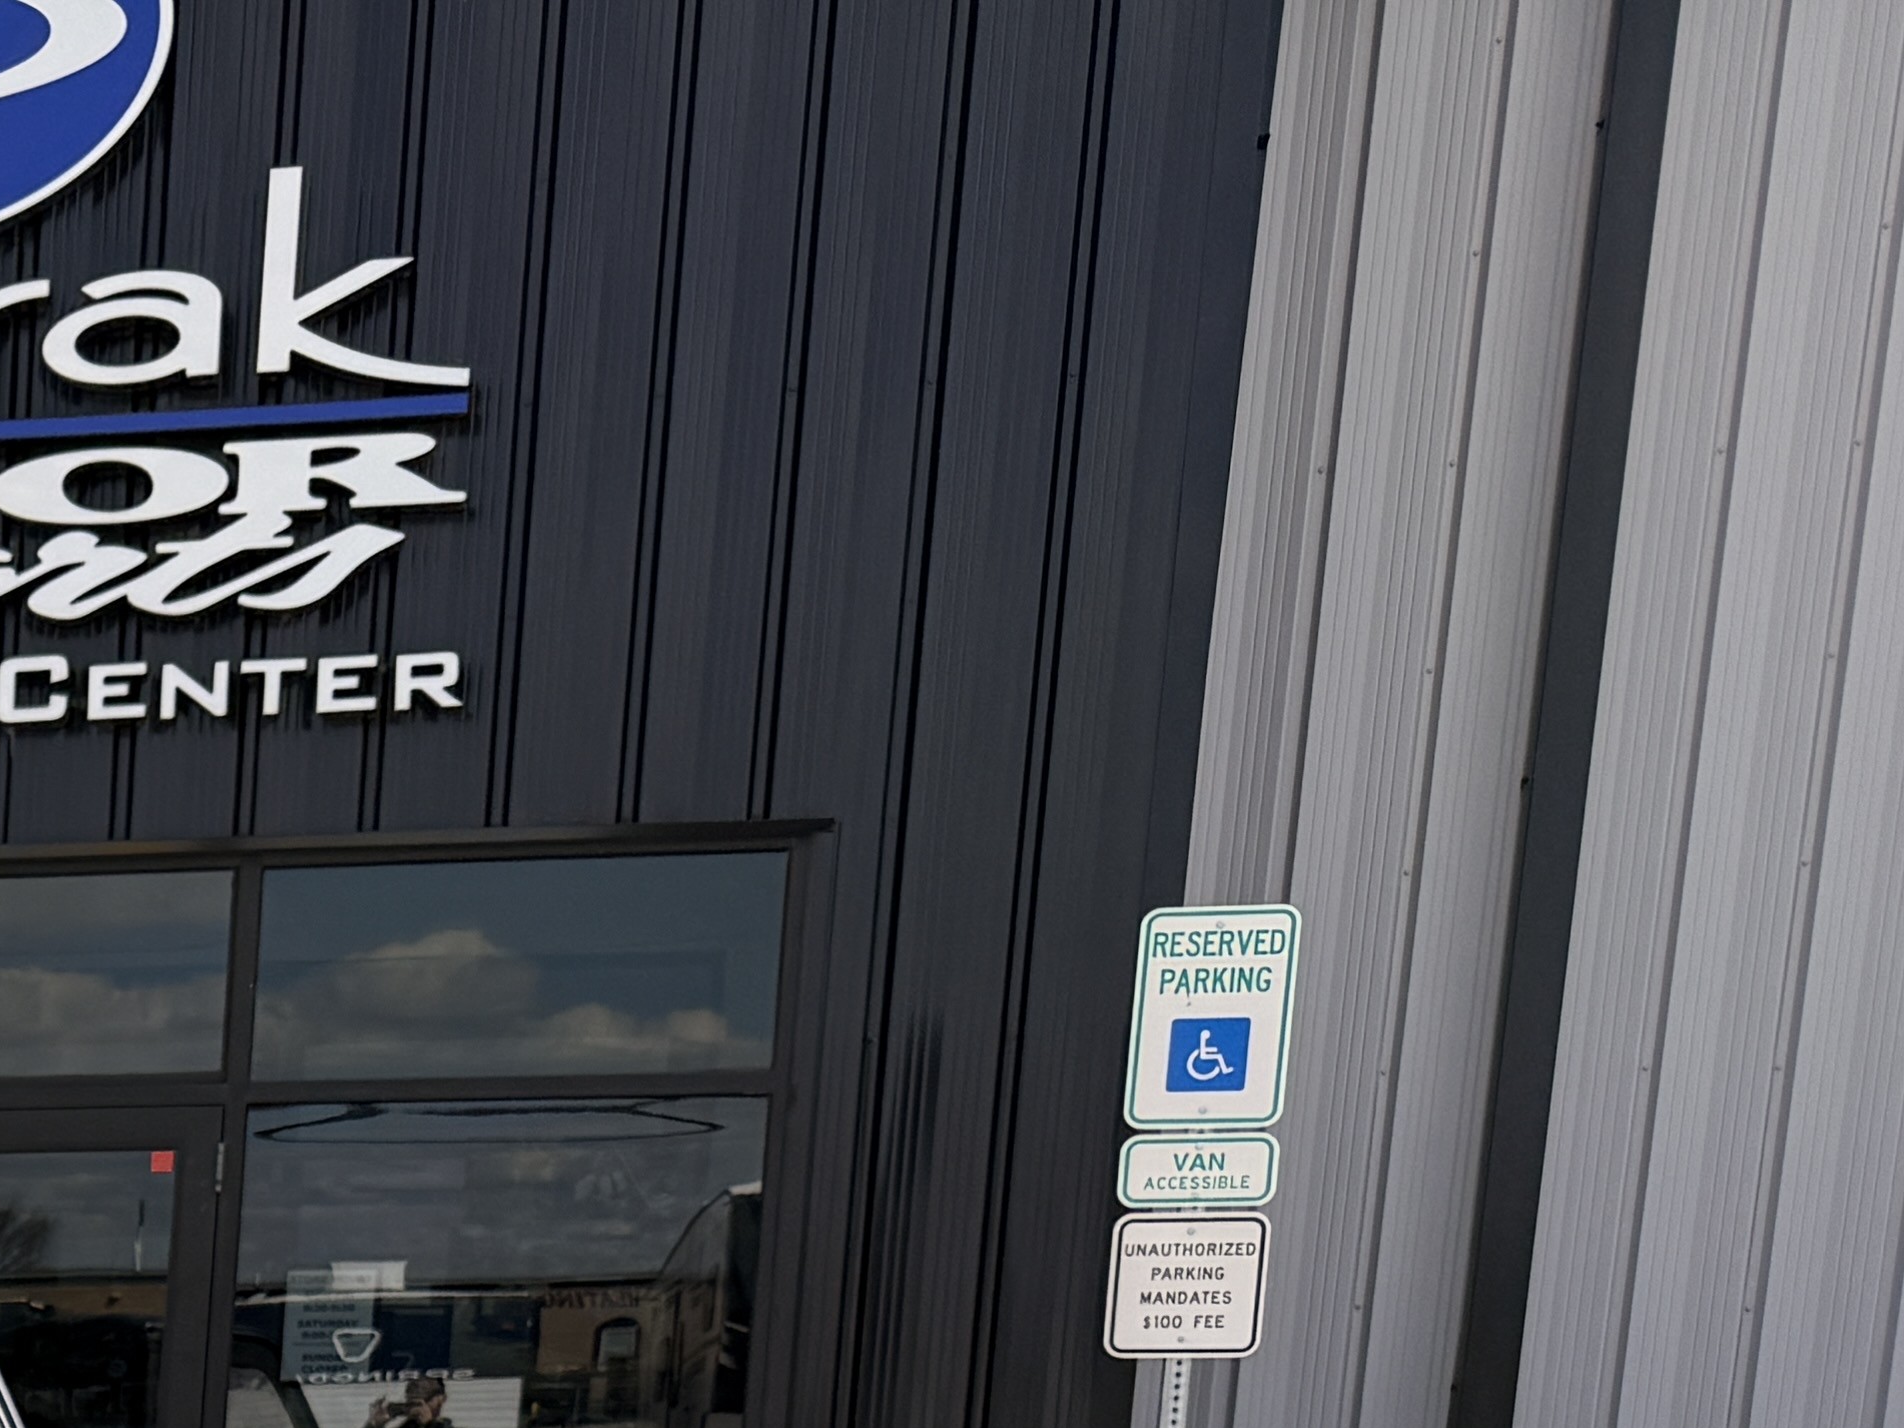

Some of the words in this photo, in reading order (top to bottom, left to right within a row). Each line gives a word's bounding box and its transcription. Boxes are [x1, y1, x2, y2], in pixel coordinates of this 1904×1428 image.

[1153, 929, 1286, 958] RESERVED
[1160, 966, 1272, 994] PARKING
[1173, 1153, 1225, 1172] VAN
[1144, 1175, 1250, 1191] ACCESSIBLE
[1125, 1242, 1257, 1258] UNAUTHORIZED
[1151, 1266, 1225, 1282] PARKING
[1140, 1290, 1232, 1306] MANDATES
[1143, 1314, 1182, 1330] $100
[1193, 1314, 1225, 1329] FEE
